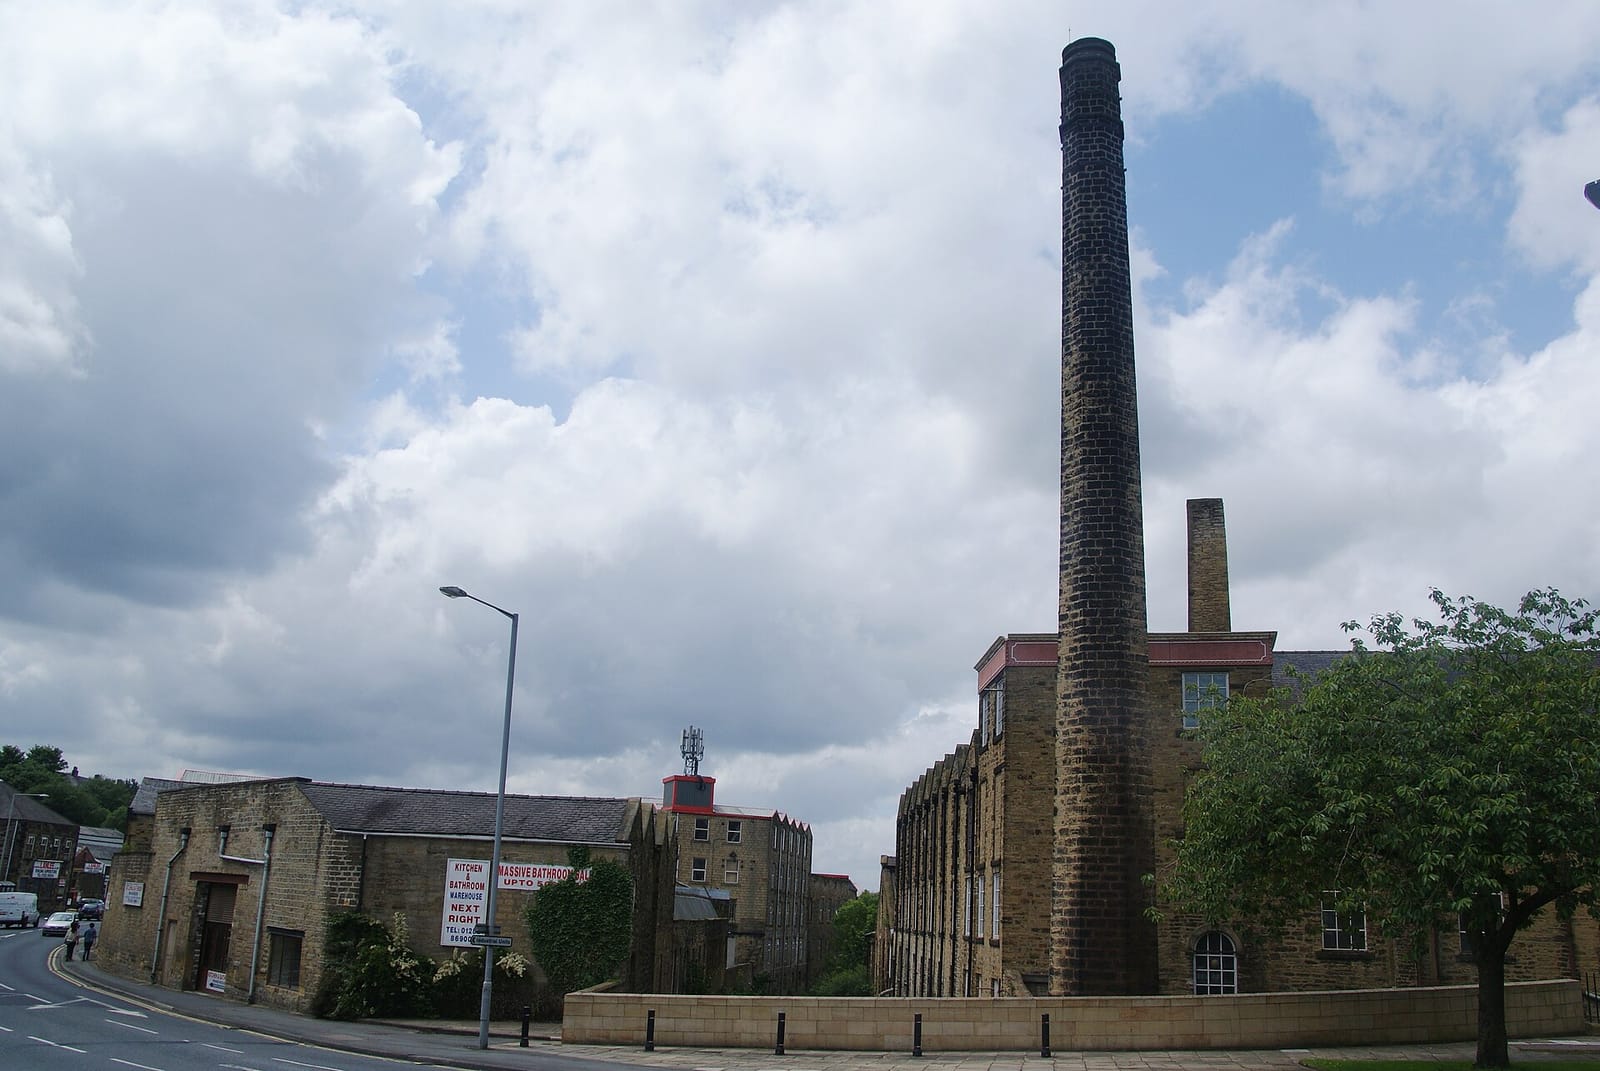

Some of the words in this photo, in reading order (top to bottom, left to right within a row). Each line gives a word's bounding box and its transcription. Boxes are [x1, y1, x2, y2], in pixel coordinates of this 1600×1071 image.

[455, 863, 483, 873] KITCHEN
[498, 865, 531, 877] MASSIVE
[449, 881, 485, 890] BATHROOM
[450, 891, 483, 900] WAREHOUSE
[451, 903, 480, 913] NEXT
[448, 914, 481, 924] RIGHT
